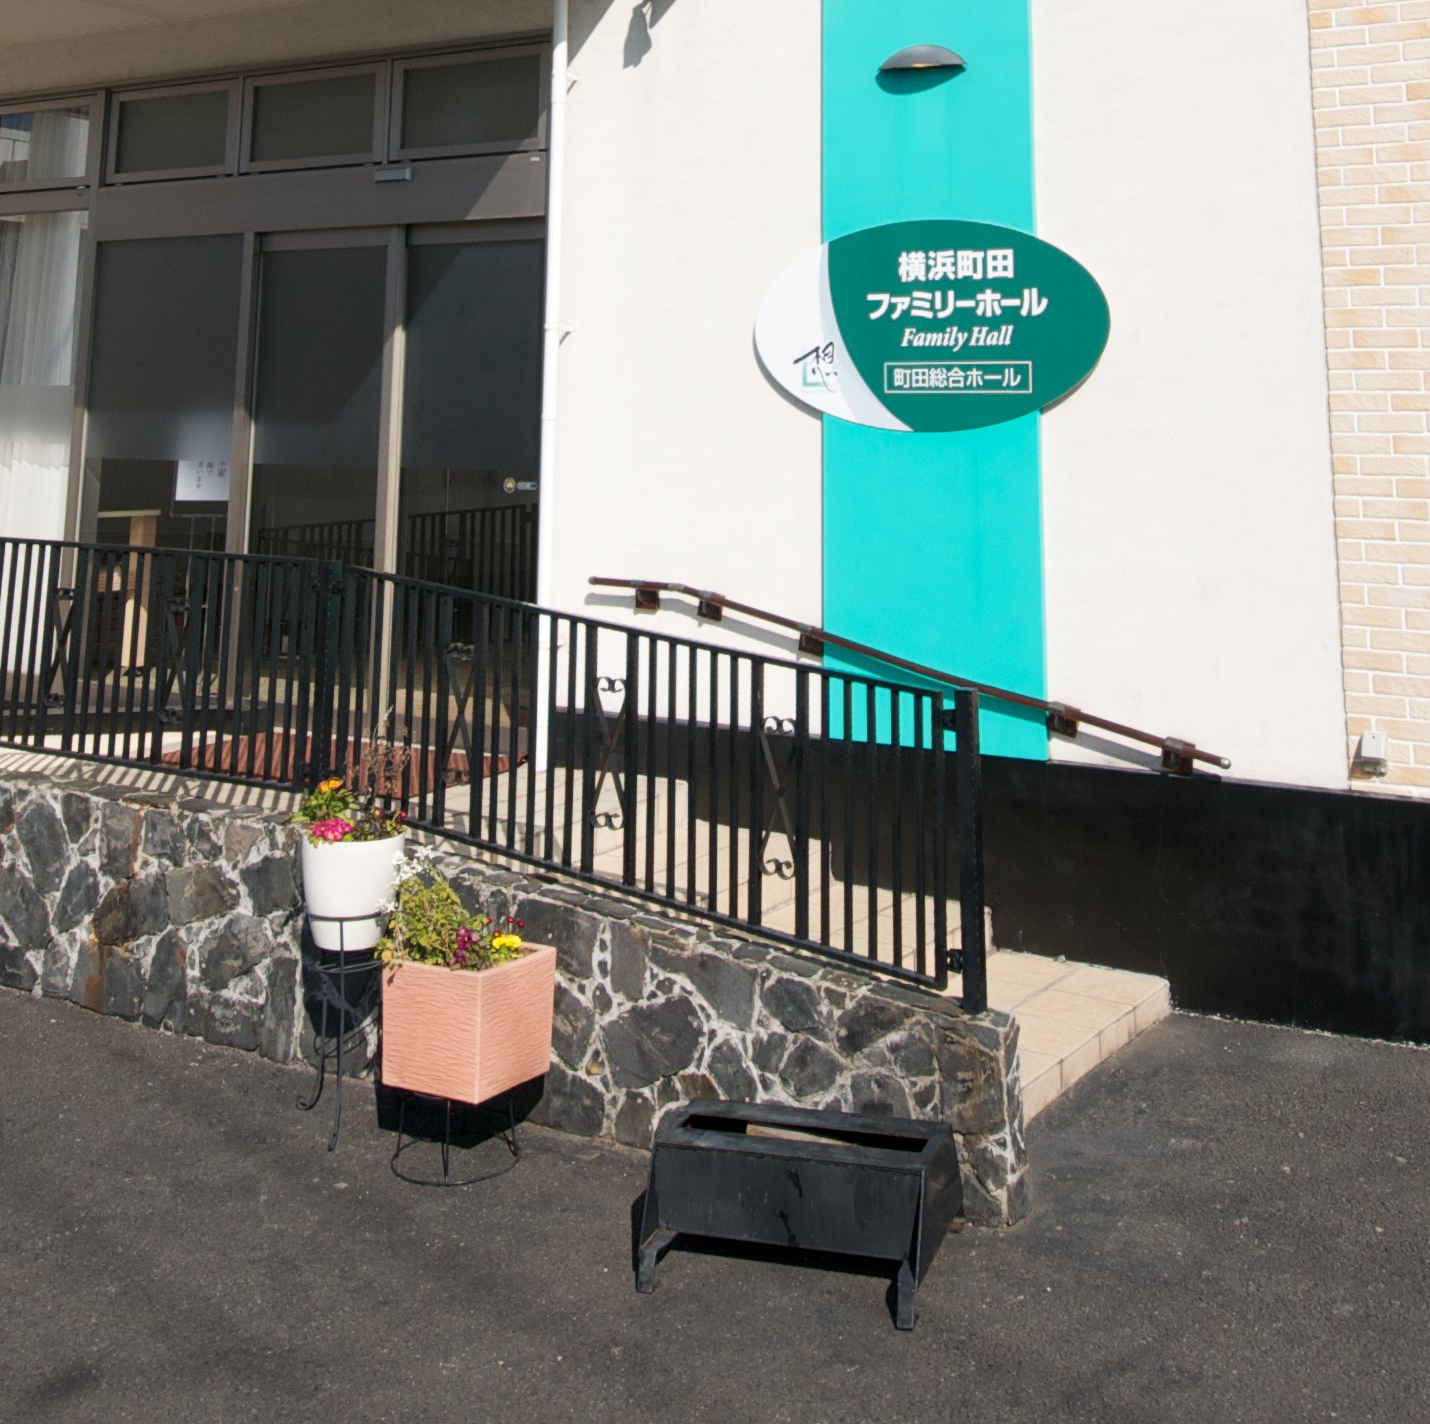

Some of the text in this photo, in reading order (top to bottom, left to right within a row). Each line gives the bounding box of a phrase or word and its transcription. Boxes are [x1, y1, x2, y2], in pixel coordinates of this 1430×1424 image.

[899, 249, 1014, 282] 横浜町田
[867, 288, 1048, 320] ファミリーホール
[901, 325, 1013, 351] Family Hall
[894, 367, 1021, 388] 町田総合ホール
